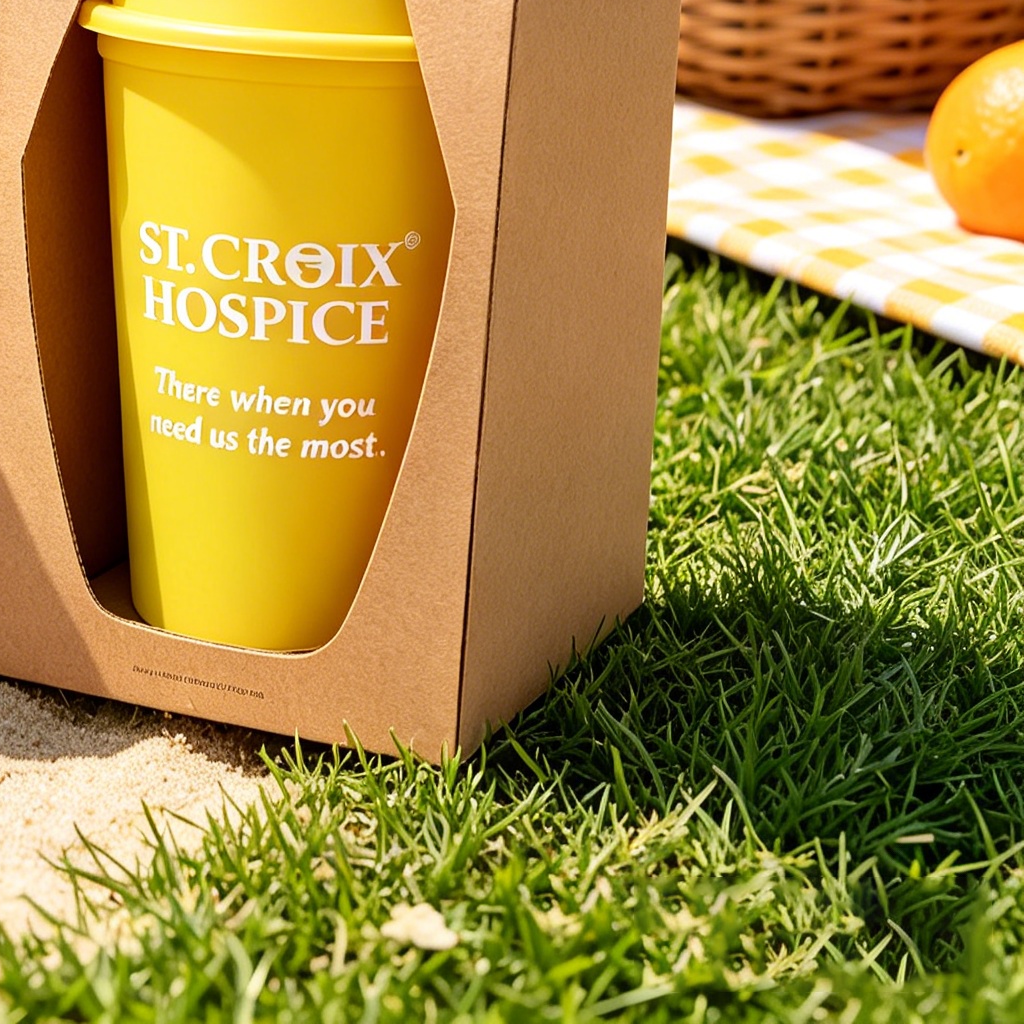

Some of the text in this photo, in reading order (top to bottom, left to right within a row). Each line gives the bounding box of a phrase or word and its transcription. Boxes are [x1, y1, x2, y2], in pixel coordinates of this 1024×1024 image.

[139, 221, 195, 275] ST.
[142, 275, 389, 346] HOSPICE
[154, 366, 376, 427] There when you
[150, 414, 386, 460] need us the most.
